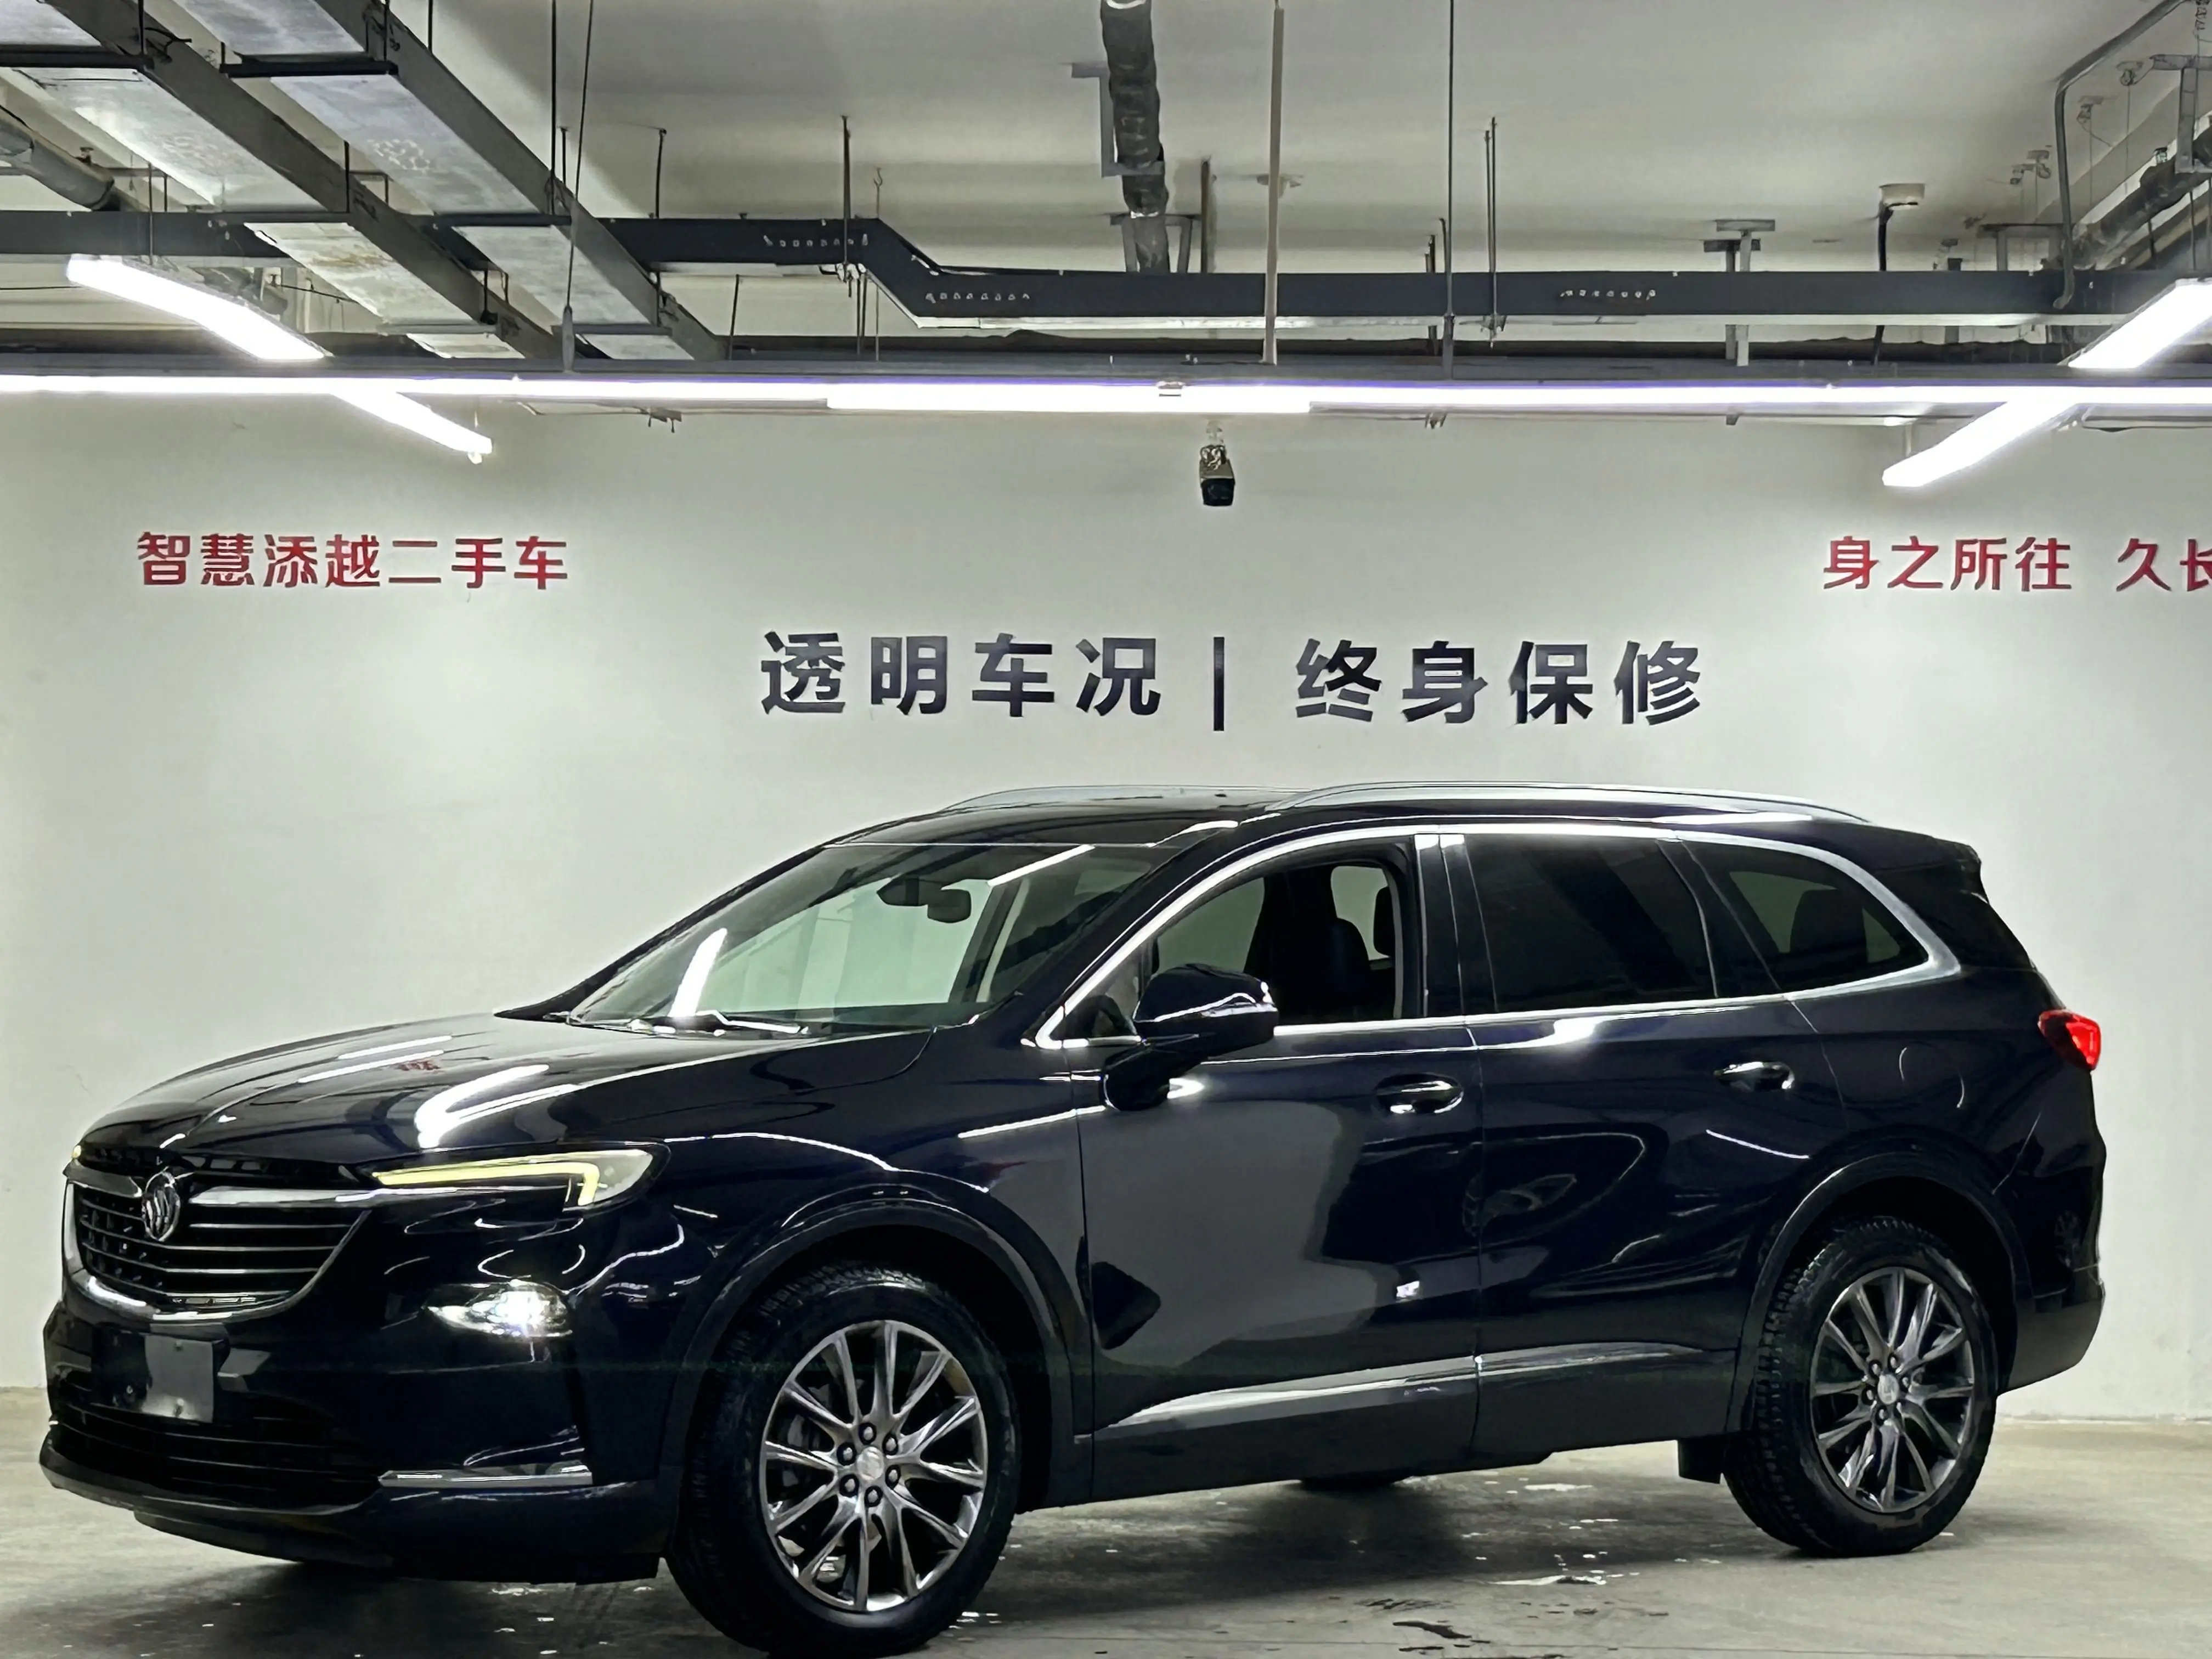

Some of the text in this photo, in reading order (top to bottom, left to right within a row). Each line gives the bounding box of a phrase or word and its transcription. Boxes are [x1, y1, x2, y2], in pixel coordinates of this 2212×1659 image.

[137, 532, 568, 590] 智慧添越二手车
[1823, 535, 2072, 591] 身之所往
[761, 631, 1161, 716] 透明车况
[1295, 638, 1703, 726] 终身保修
